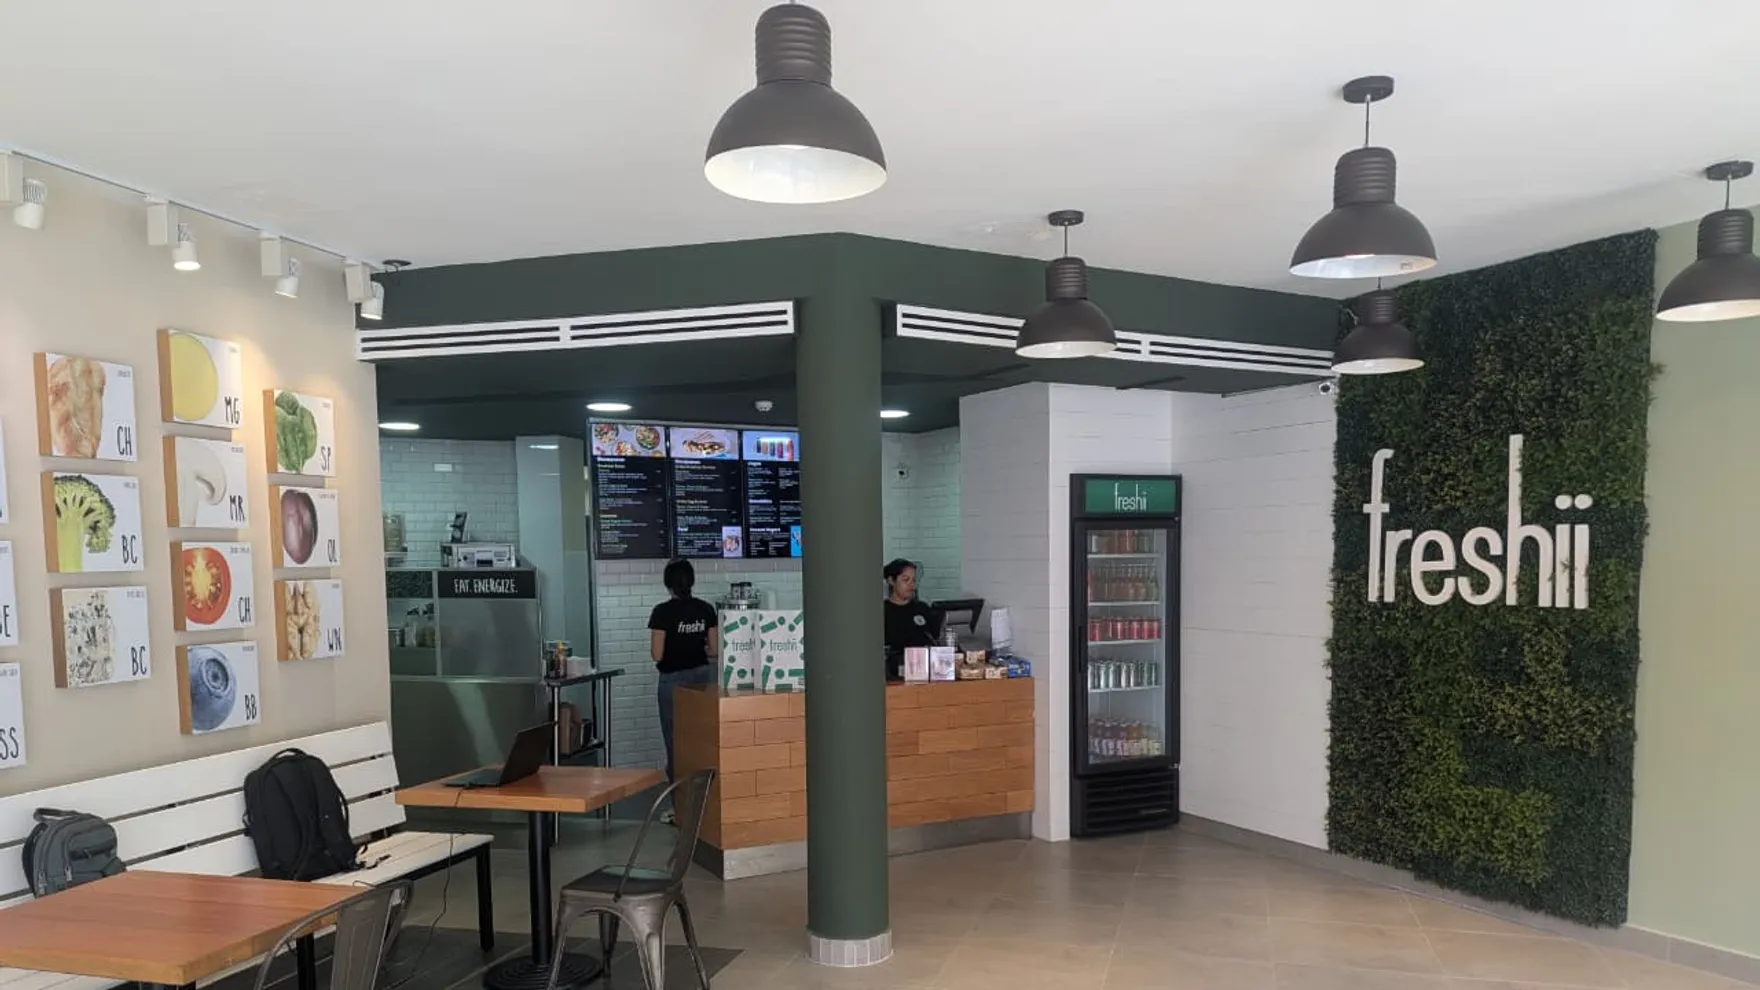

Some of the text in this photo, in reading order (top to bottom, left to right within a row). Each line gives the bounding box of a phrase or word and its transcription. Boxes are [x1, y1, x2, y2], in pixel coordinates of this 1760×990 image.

[224, 396, 240, 424] MG
[116, 425, 133, 456] CH
[320, 446, 332, 471] SP
[229, 495, 246, 521] MR
[1363, 434, 1593, 609] freshii
[121, 534, 139, 565] BC
[0, 604, 11, 637] E
[238, 597, 252, 623] CH
[327, 627, 342, 652] WN
[130, 645, 147, 676] BC
[244, 694, 257, 721] BB
